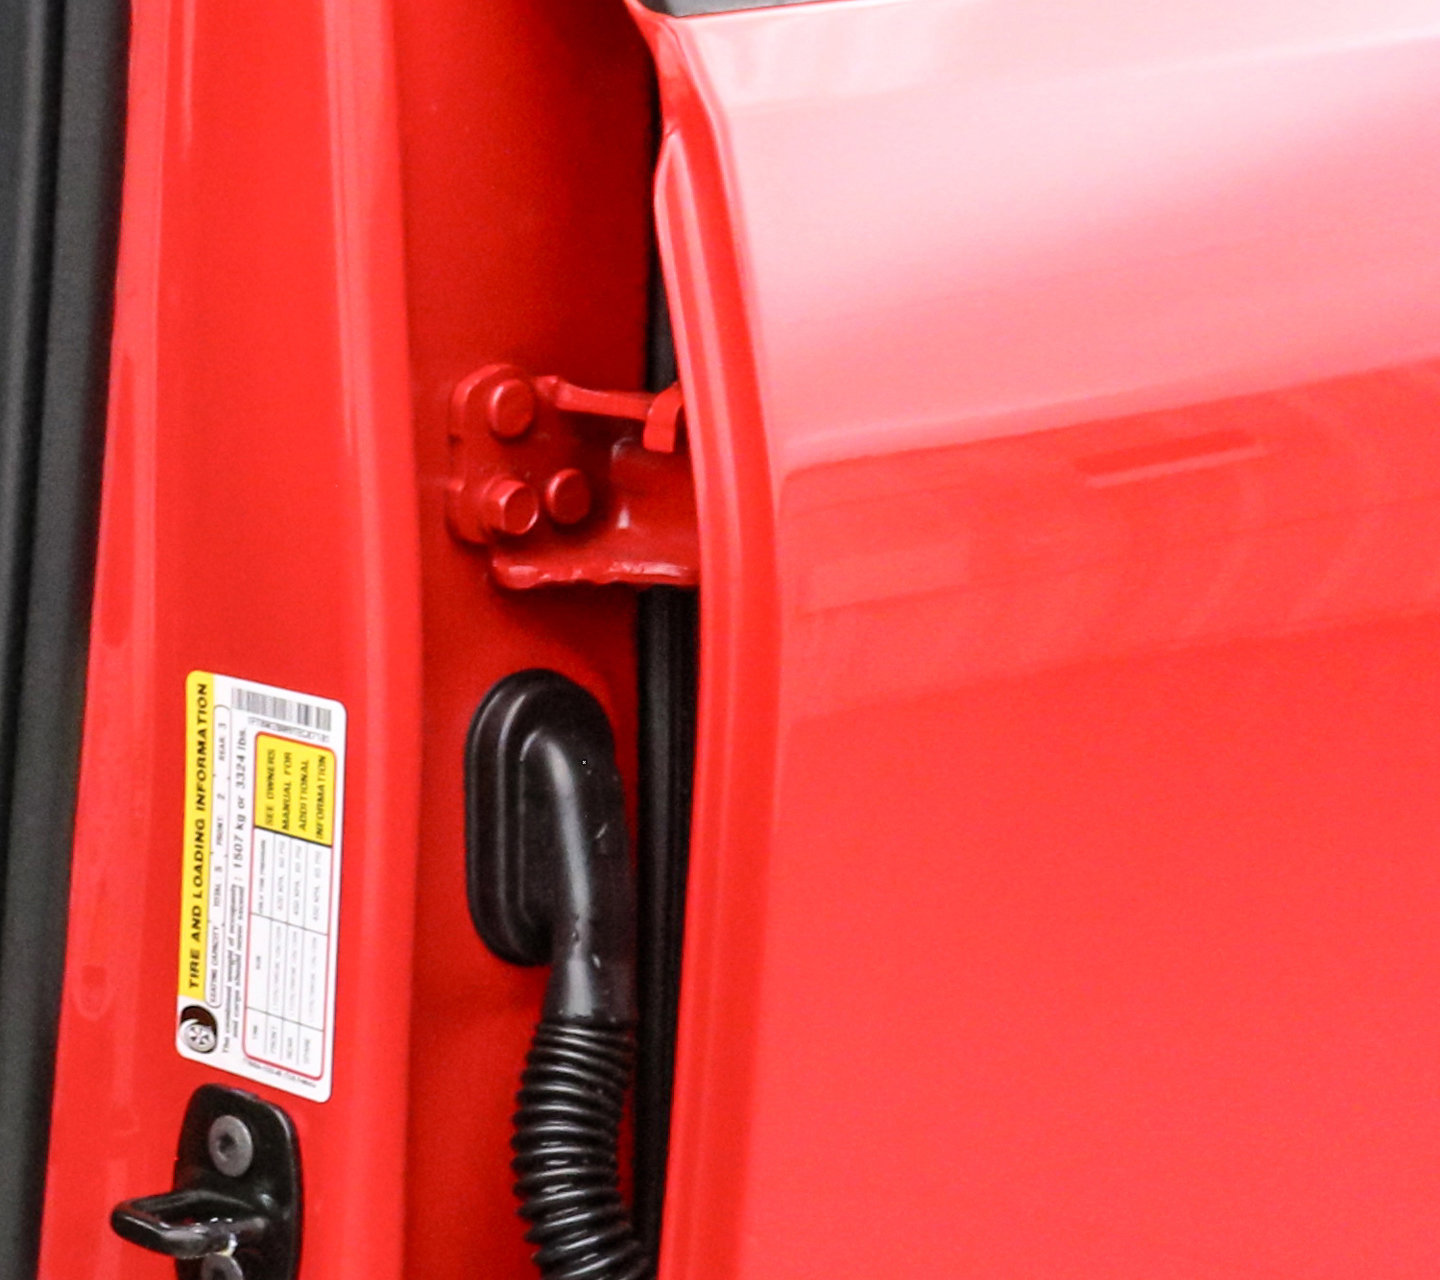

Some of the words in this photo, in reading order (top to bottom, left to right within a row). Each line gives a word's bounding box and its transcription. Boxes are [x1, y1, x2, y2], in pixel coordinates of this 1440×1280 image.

[196, 683, 207, 811] INFORMATION
[283, 752, 291, 775] FOR
[236, 755, 245, 789] 3324
[238, 796, 245, 809] or
[282, 781, 291, 831] MANUAL
[299, 760, 309, 831] ADDITIONAL
[316, 755, 326, 839] INFORMATION
[235, 814, 246, 830] kg
[193, 818, 205, 899] LOADING
[233, 835, 243, 868] 1507
[192, 905, 201, 942] AND
[189, 949, 199, 988] TIRE
